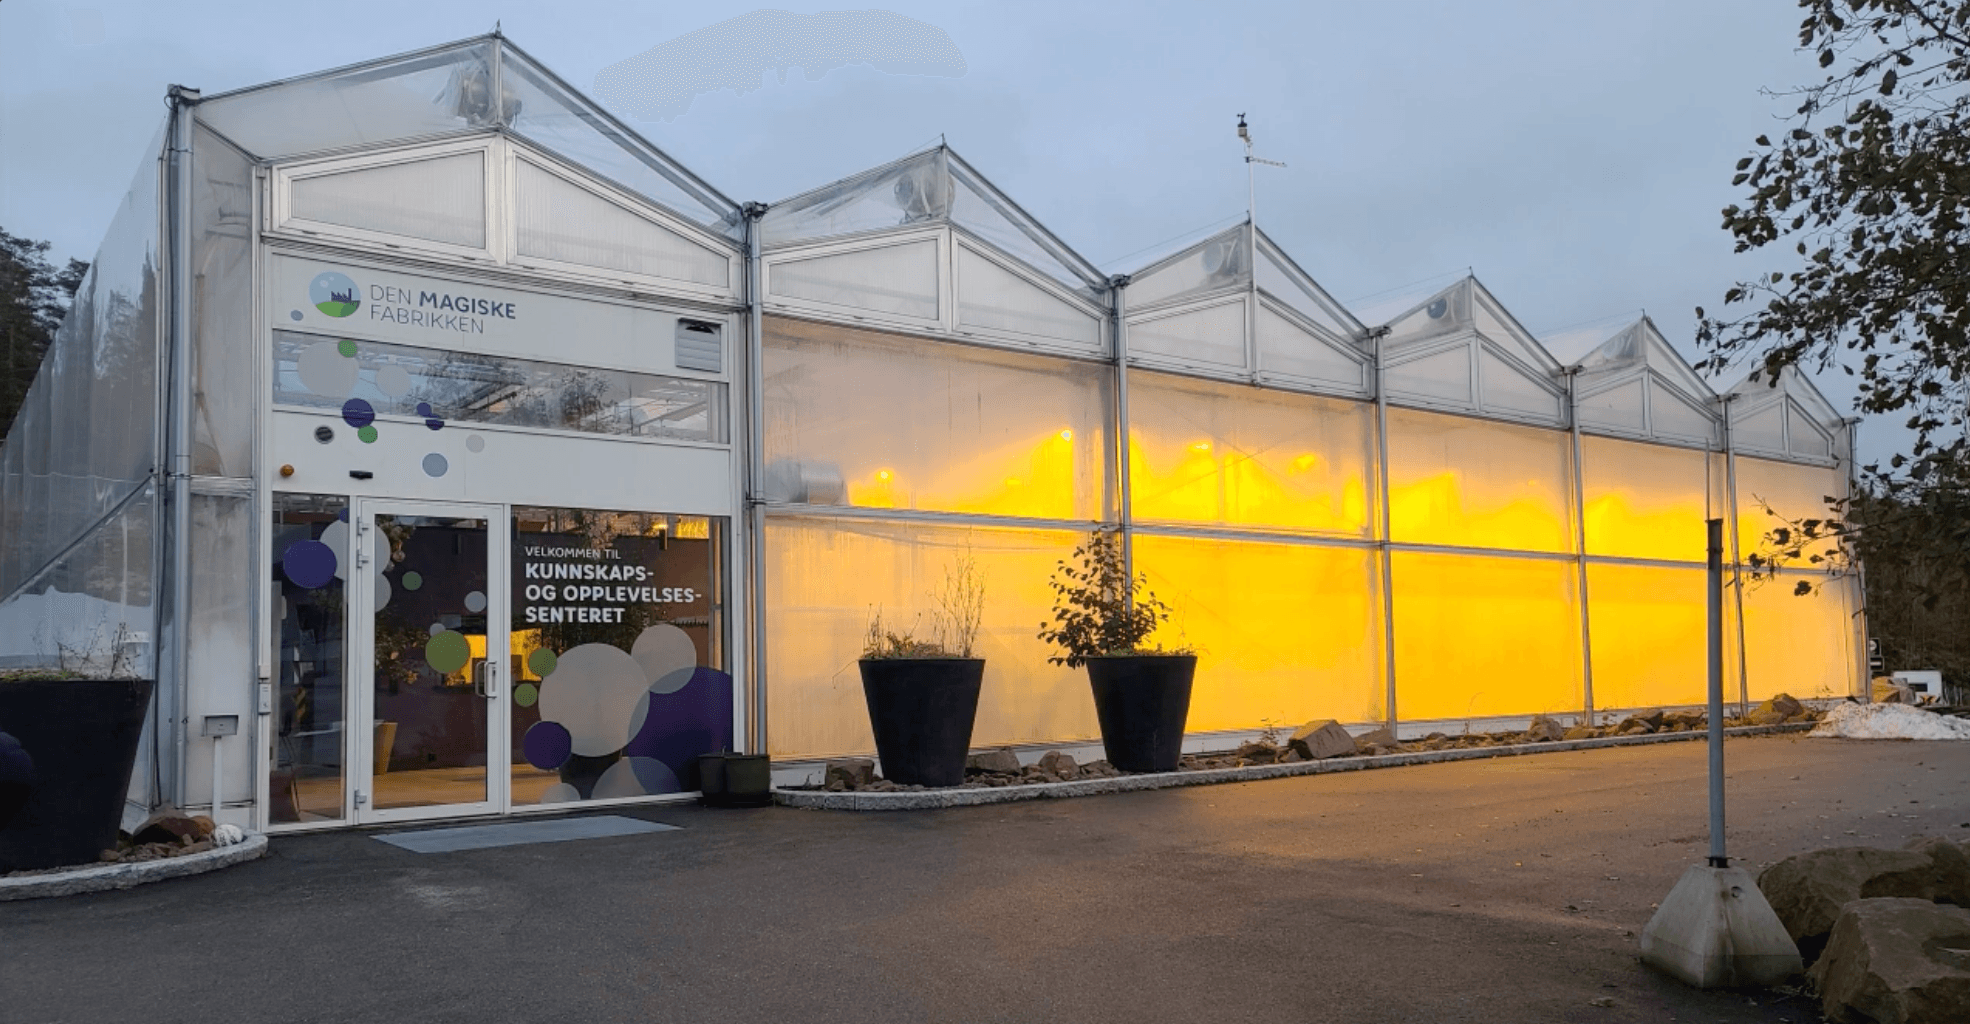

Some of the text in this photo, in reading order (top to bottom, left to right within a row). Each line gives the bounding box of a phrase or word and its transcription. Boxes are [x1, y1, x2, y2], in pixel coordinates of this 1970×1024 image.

[370, 284, 516, 320] DEN MAGISKE
[370, 304, 484, 334] FABRIKKEN
[524, 546, 622, 560] VELKOMMEN TIL
[525, 562, 654, 581] KUNNSKAPS-
[525, 584, 702, 603] OG OPPLEVELSES-
[525, 606, 625, 623] SENTERET
